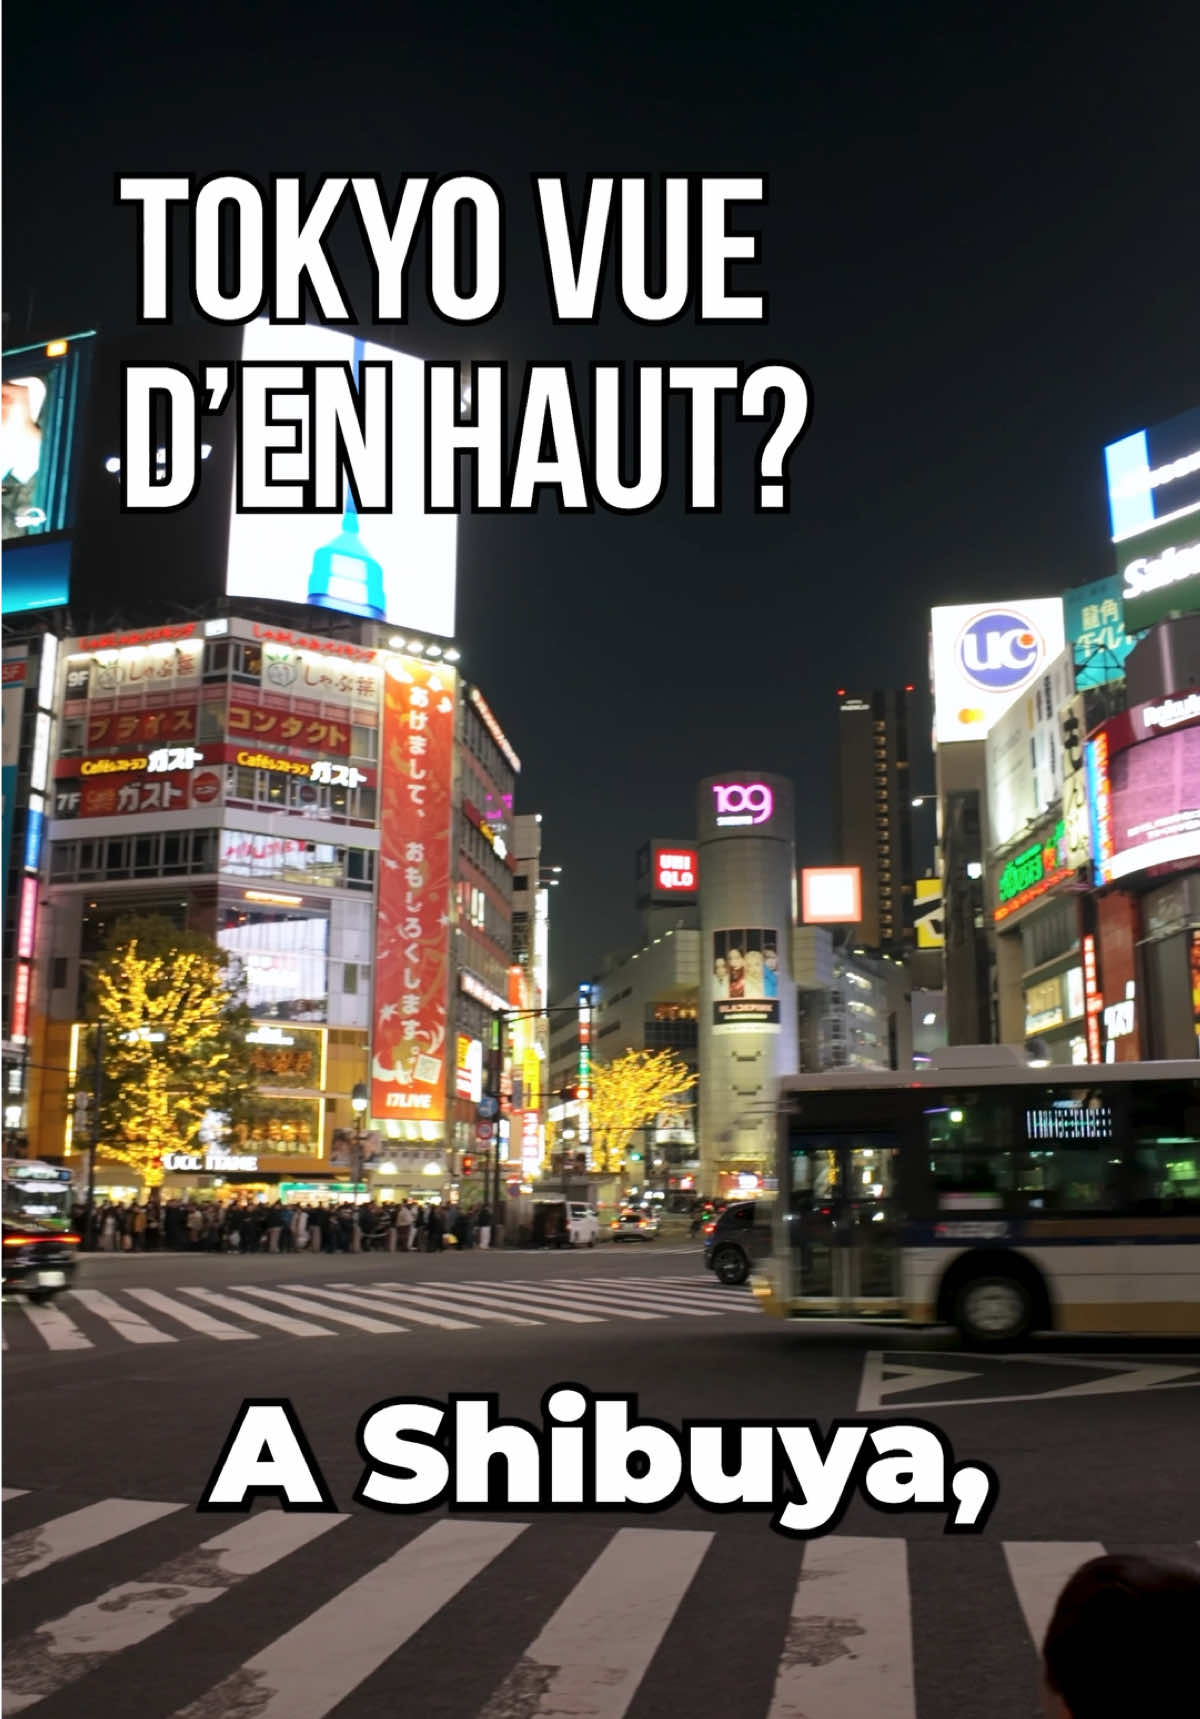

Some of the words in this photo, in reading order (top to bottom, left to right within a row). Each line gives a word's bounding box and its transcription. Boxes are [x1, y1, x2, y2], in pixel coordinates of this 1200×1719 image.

[68, 670, 89, 688] 9F
[90, 709, 193, 743] プライス
[227, 706, 348, 748] コンタクト
[147, 747, 204, 773] ガスト
[310, 760, 368, 788] ガスト
[56, 792, 81, 811] 7F
[116, 780, 183, 812] ガスト
[711, 783, 774, 825] 109
